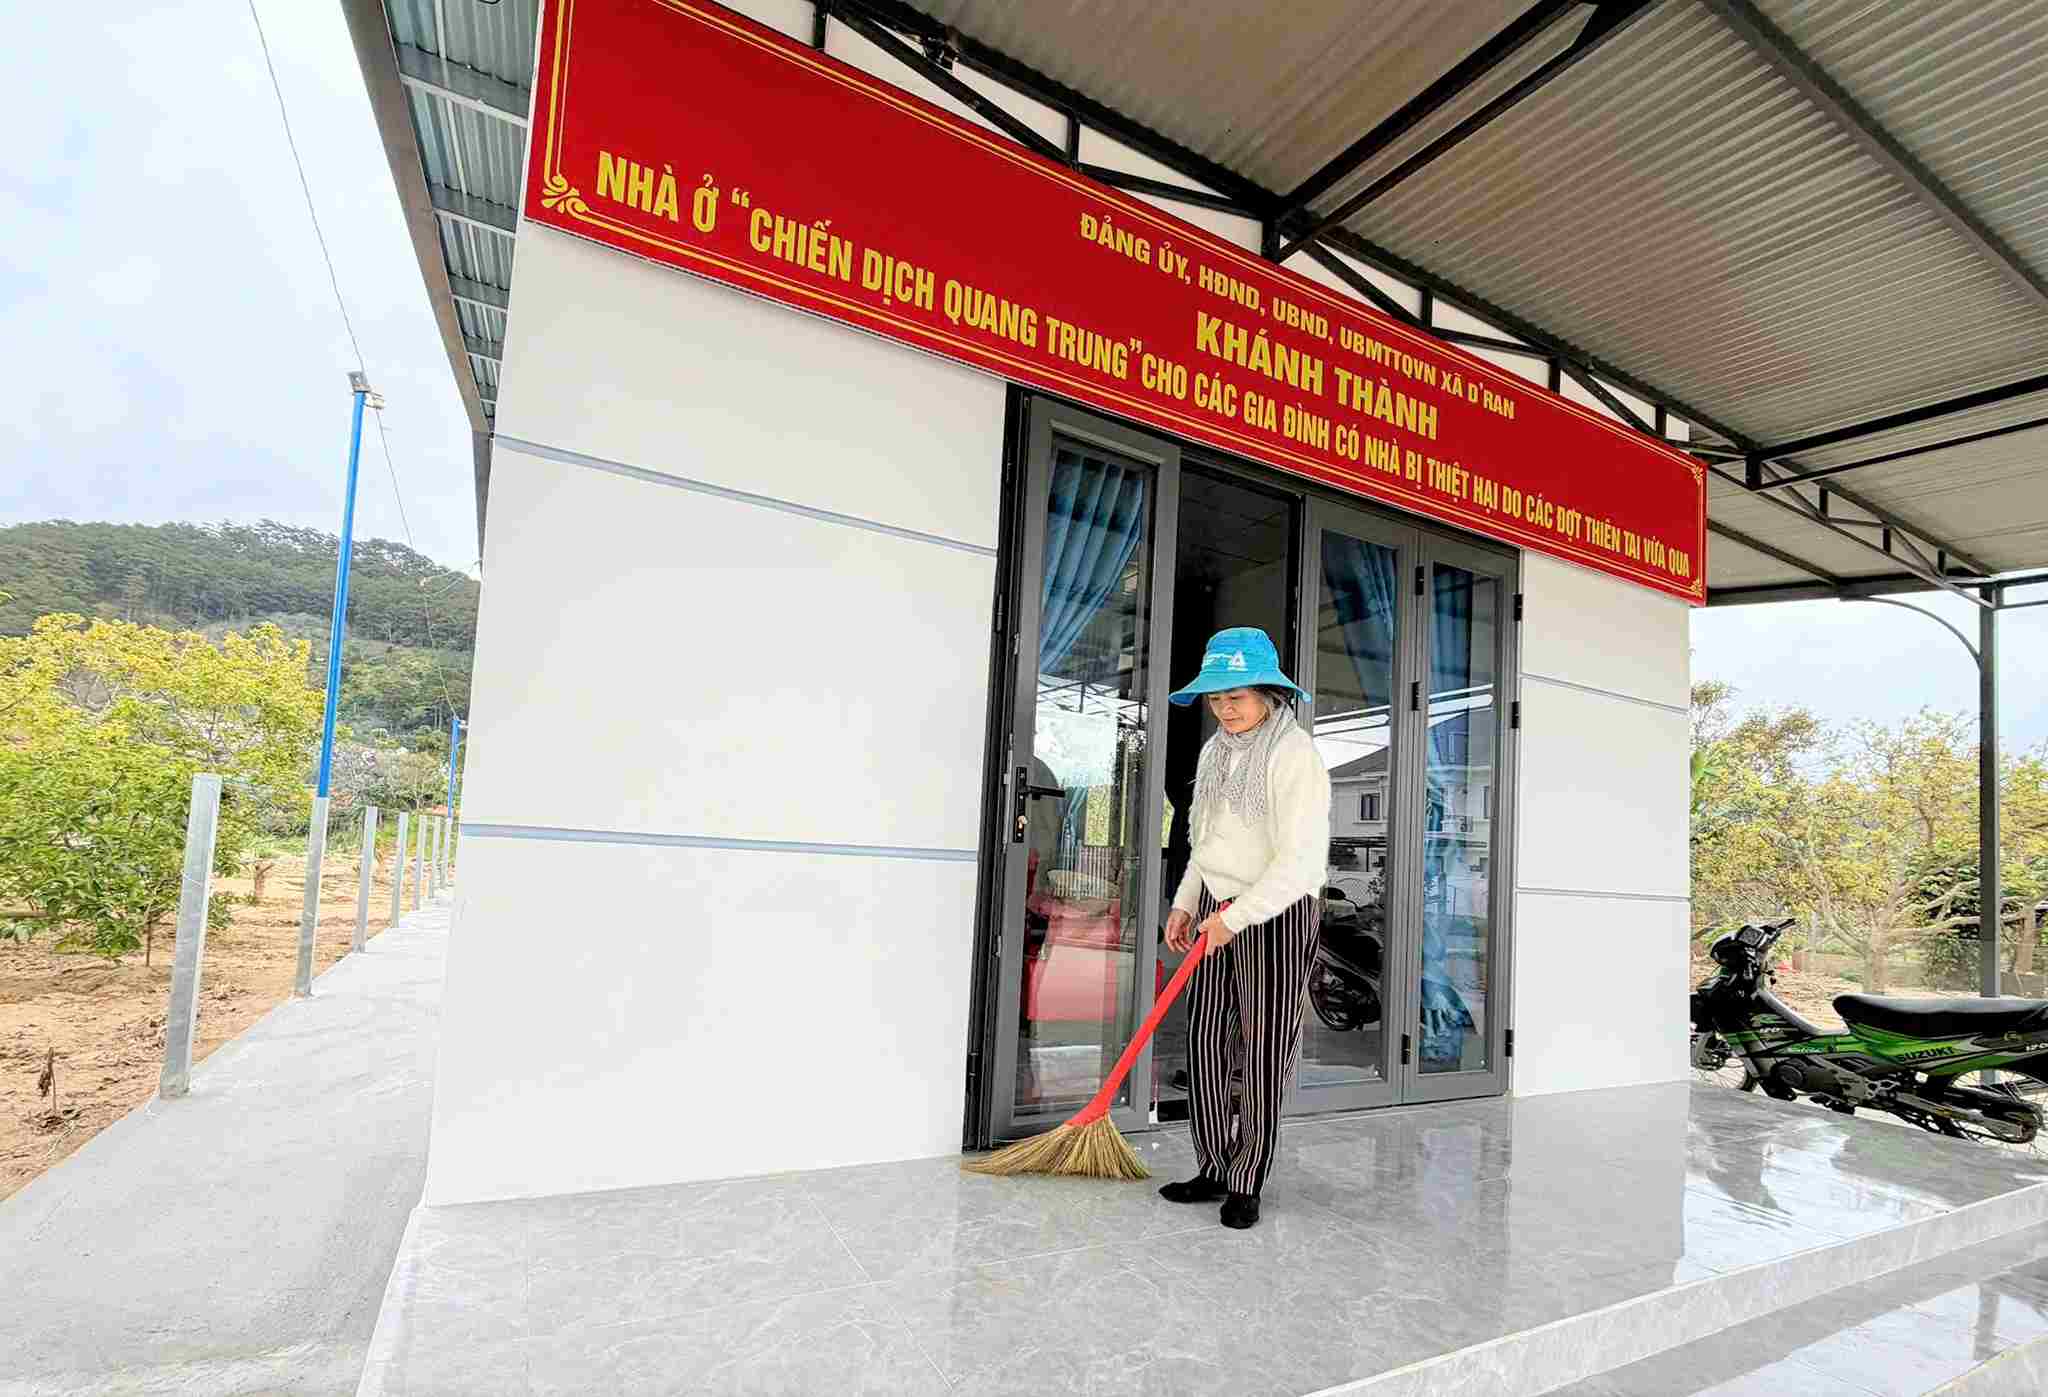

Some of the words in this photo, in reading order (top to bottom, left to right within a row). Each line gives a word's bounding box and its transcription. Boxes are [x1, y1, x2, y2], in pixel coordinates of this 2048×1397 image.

[596, 150, 679, 222] NHÀ
[692, 173, 720, 233] Ở
[862, 247, 935, 311] DỊCH
[944, 279, 1038, 348] QUANG
[1194, 372, 1238, 418] CÁC
[1243, 390, 1277, 433] GIA
[1283, 402, 1330, 452] ĐÌNH
[1335, 422, 1360, 461] CÓ
[1364, 434, 1401, 476] NHÀ
[1405, 449, 1423, 490] BỊ
[1426, 457, 1470, 503] THIỆT
[1472, 475, 1499, 514] HẠI
[1502, 485, 1522, 519] DO
[1525, 494, 1554, 529] CÁC
[1556, 505, 1582, 544] ĐỢT
[1584, 515, 1622, 554] THIÊN
[1623, 530, 1641, 561] TAI
[1668, 547, 1690, 578] QUA
[1080, 213, 1150, 265] ĐẢNG
[1158, 242, 1191, 284] ỦY,
[1199, 264, 1266, 316] HĐND,
[1273, 297, 1334, 345] UBND,
[1340, 327, 1437, 385] UBMTTQVN
[1440, 364, 1463, 398] XÃ
[1196, 311, 1323, 396] KHÁNH
[1334, 367, 1438, 440] THÀNH
